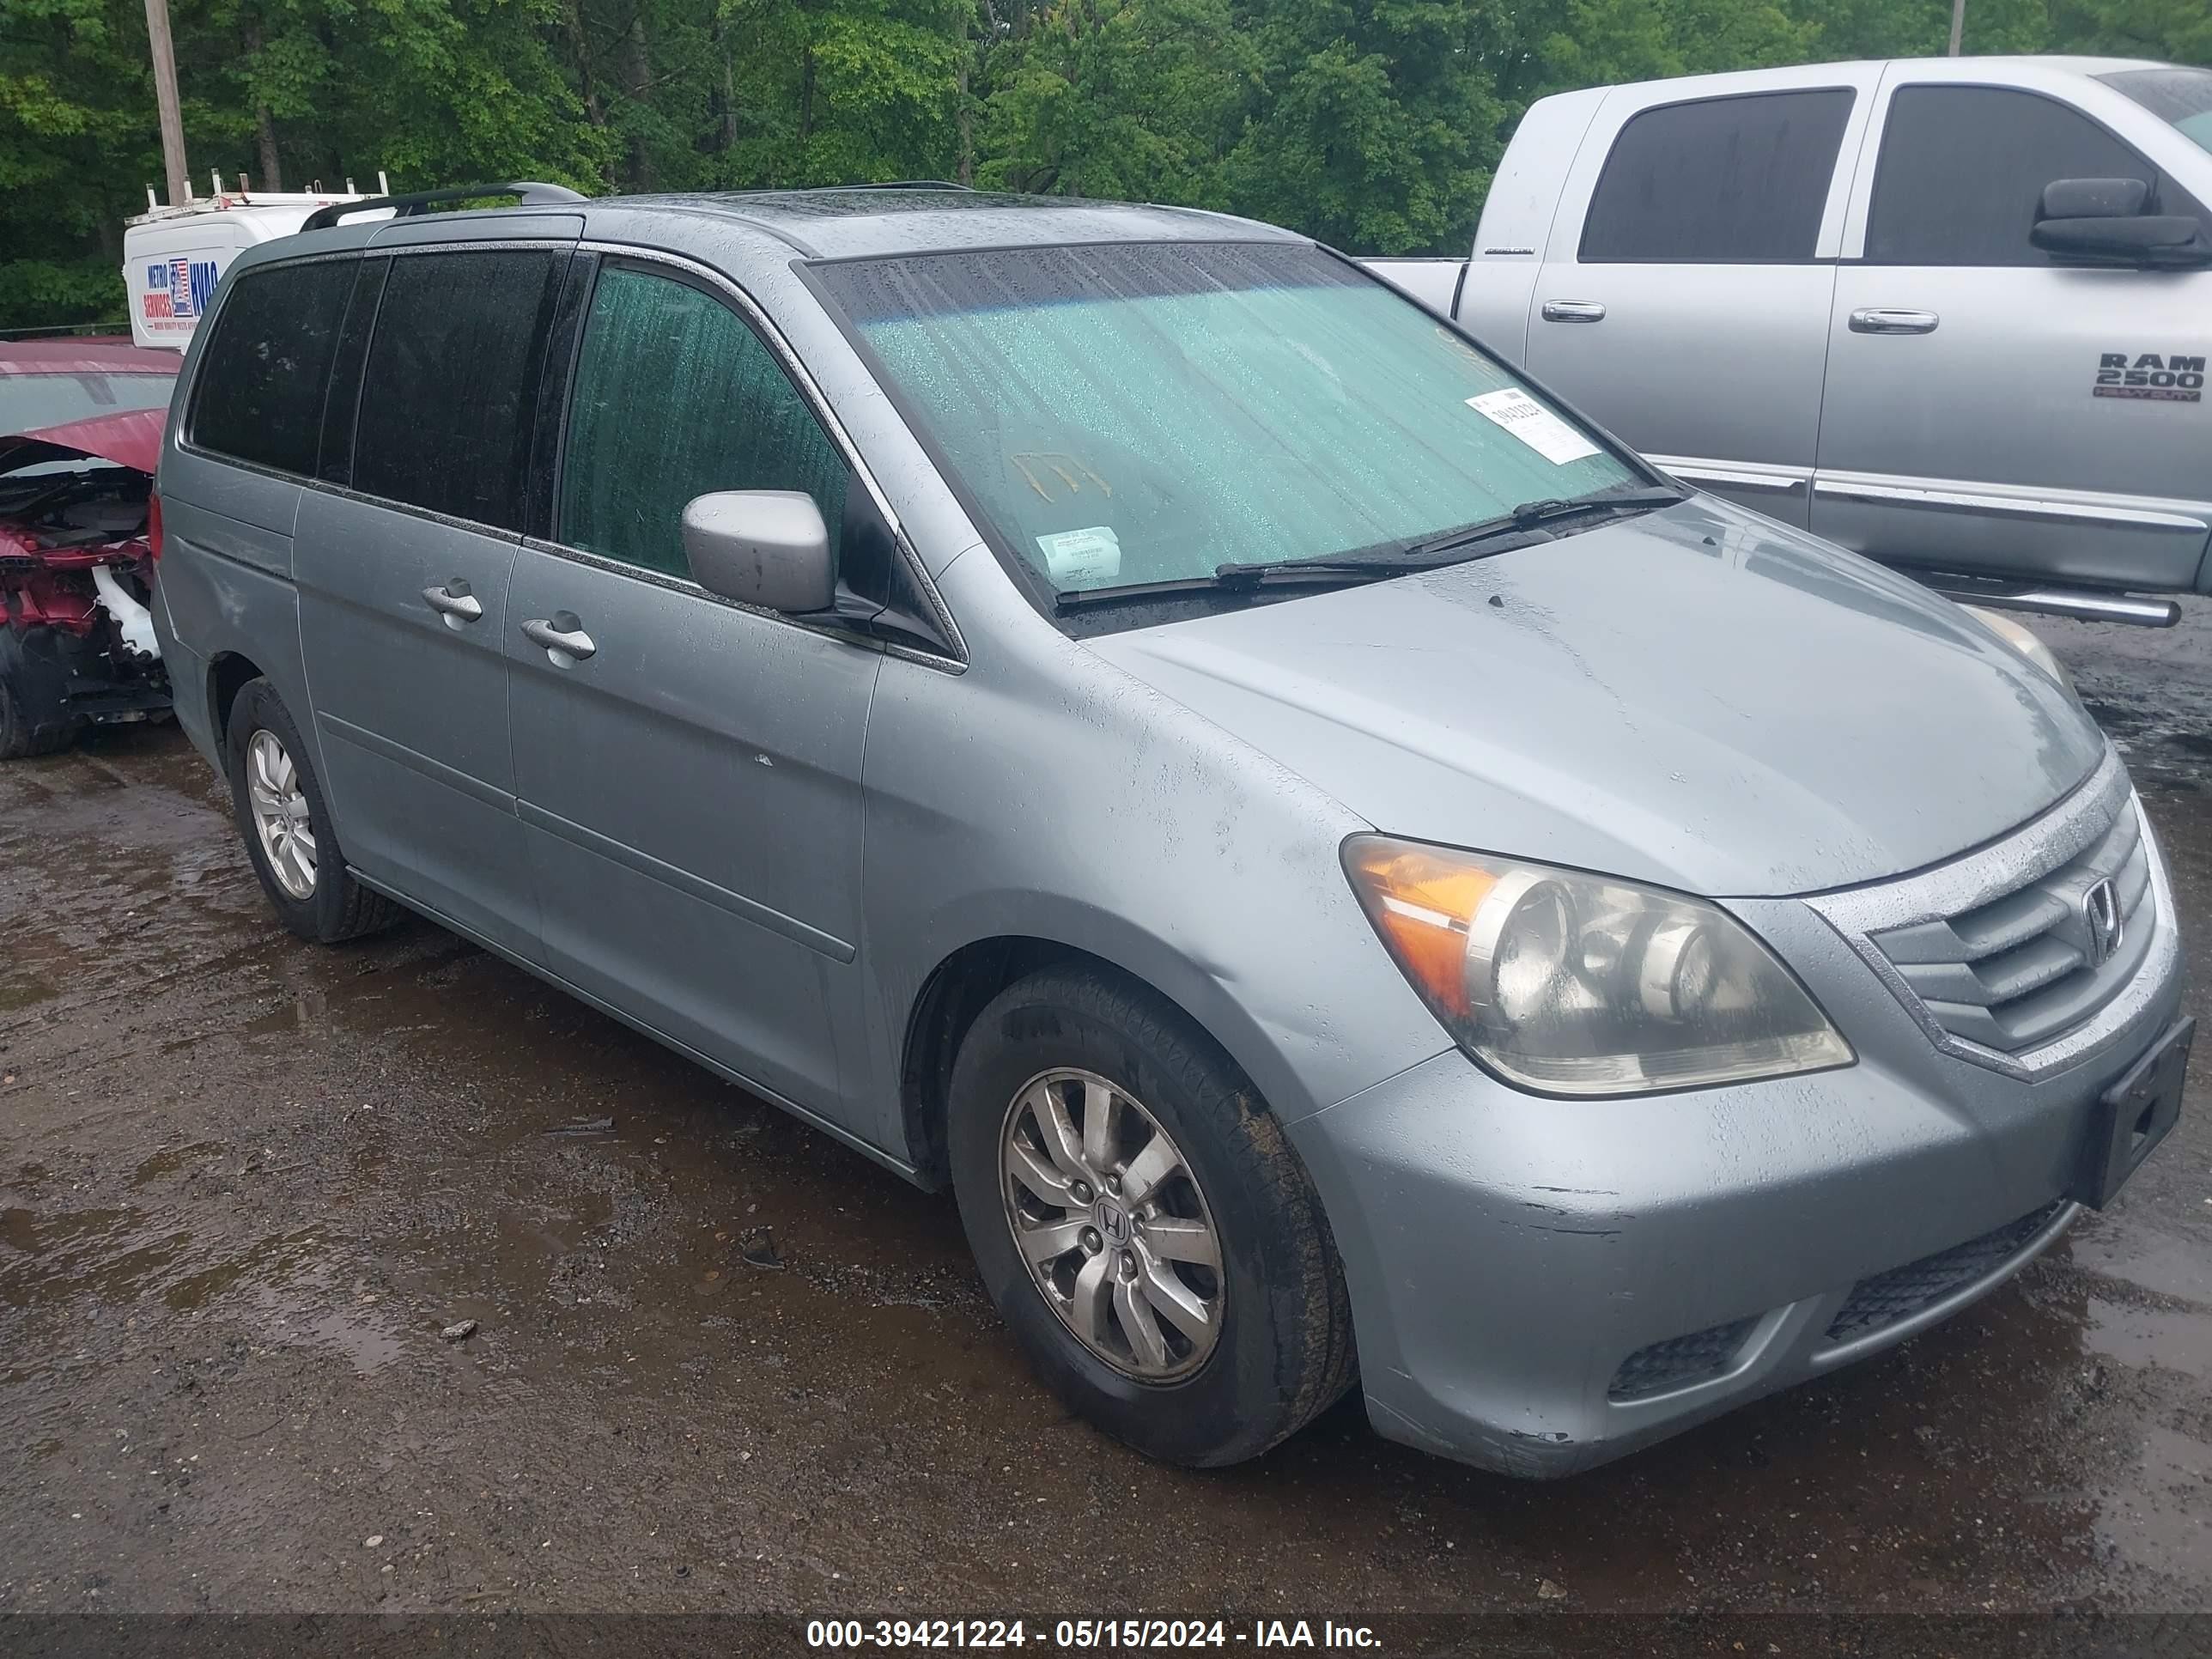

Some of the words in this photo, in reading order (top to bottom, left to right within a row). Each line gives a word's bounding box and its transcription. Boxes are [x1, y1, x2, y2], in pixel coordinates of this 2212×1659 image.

[148, 264, 168, 289] METRO
[143, 294, 173, 319] SERVICES
[2100, 353, 2206, 372] RAM
[2096, 369, 2204, 388] 2500
